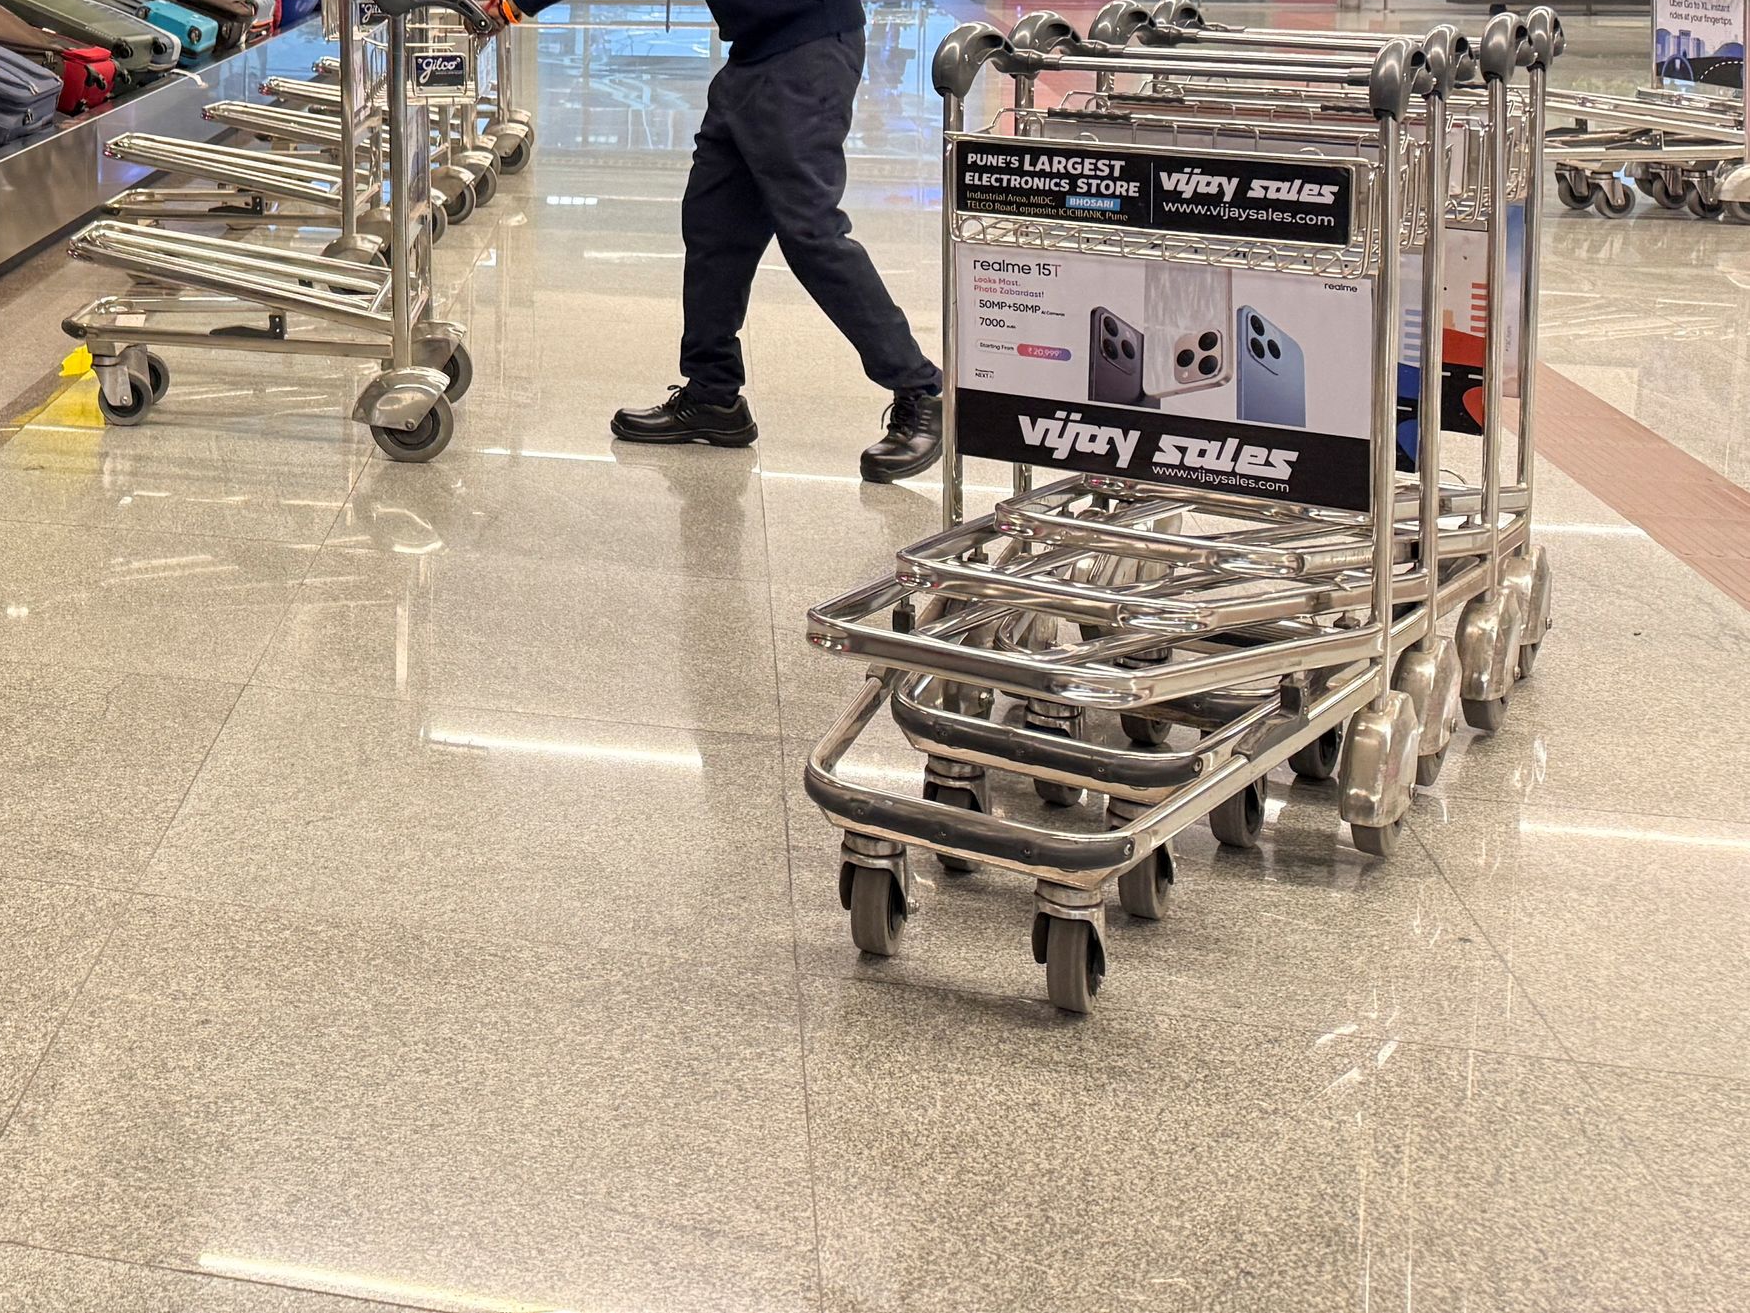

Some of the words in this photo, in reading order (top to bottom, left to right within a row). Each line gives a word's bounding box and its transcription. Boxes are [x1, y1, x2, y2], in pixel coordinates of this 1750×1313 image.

[1684, 0, 1692, 8] Go
[1694, 1, 1701, 9] to
[1711, 3, 1730, 12] instant
[1670, 11, 1683, 20] rides
[1691, 14, 1703, 23] your
[967, 153, 1019, 168] PUNE'S
[1023, 154, 1125, 178] LARGEST
[965, 172, 1070, 192] ELECTRONICS
[1076, 178, 1140, 197] STORE
[1246, 179, 1339, 205] sales
[966, 190, 1006, 201] Industrial
[1007, 193, 1028, 204] Area,
[1069, 198, 1114, 208] BHOSARI
[966, 200, 993, 210] TELCO
[995, 203, 1018, 213] Road,
[1019, 204, 1057, 216] opposite
[1106, 211, 1128, 222] Pune
[1163, 201, 1335, 227] www.vijaysales.com
[973, 259, 1032, 275] realme
[1035, 263, 1062, 278] 15T
[973, 285, 998, 294] Photo
[1324, 283, 1358, 292] realme
[979, 299, 1041, 314] 50MP+50MP
[979, 317, 1005, 328] 7000
[1152, 434, 1299, 481] sales
[1152, 465, 1290, 493] www.vijaysales.com
